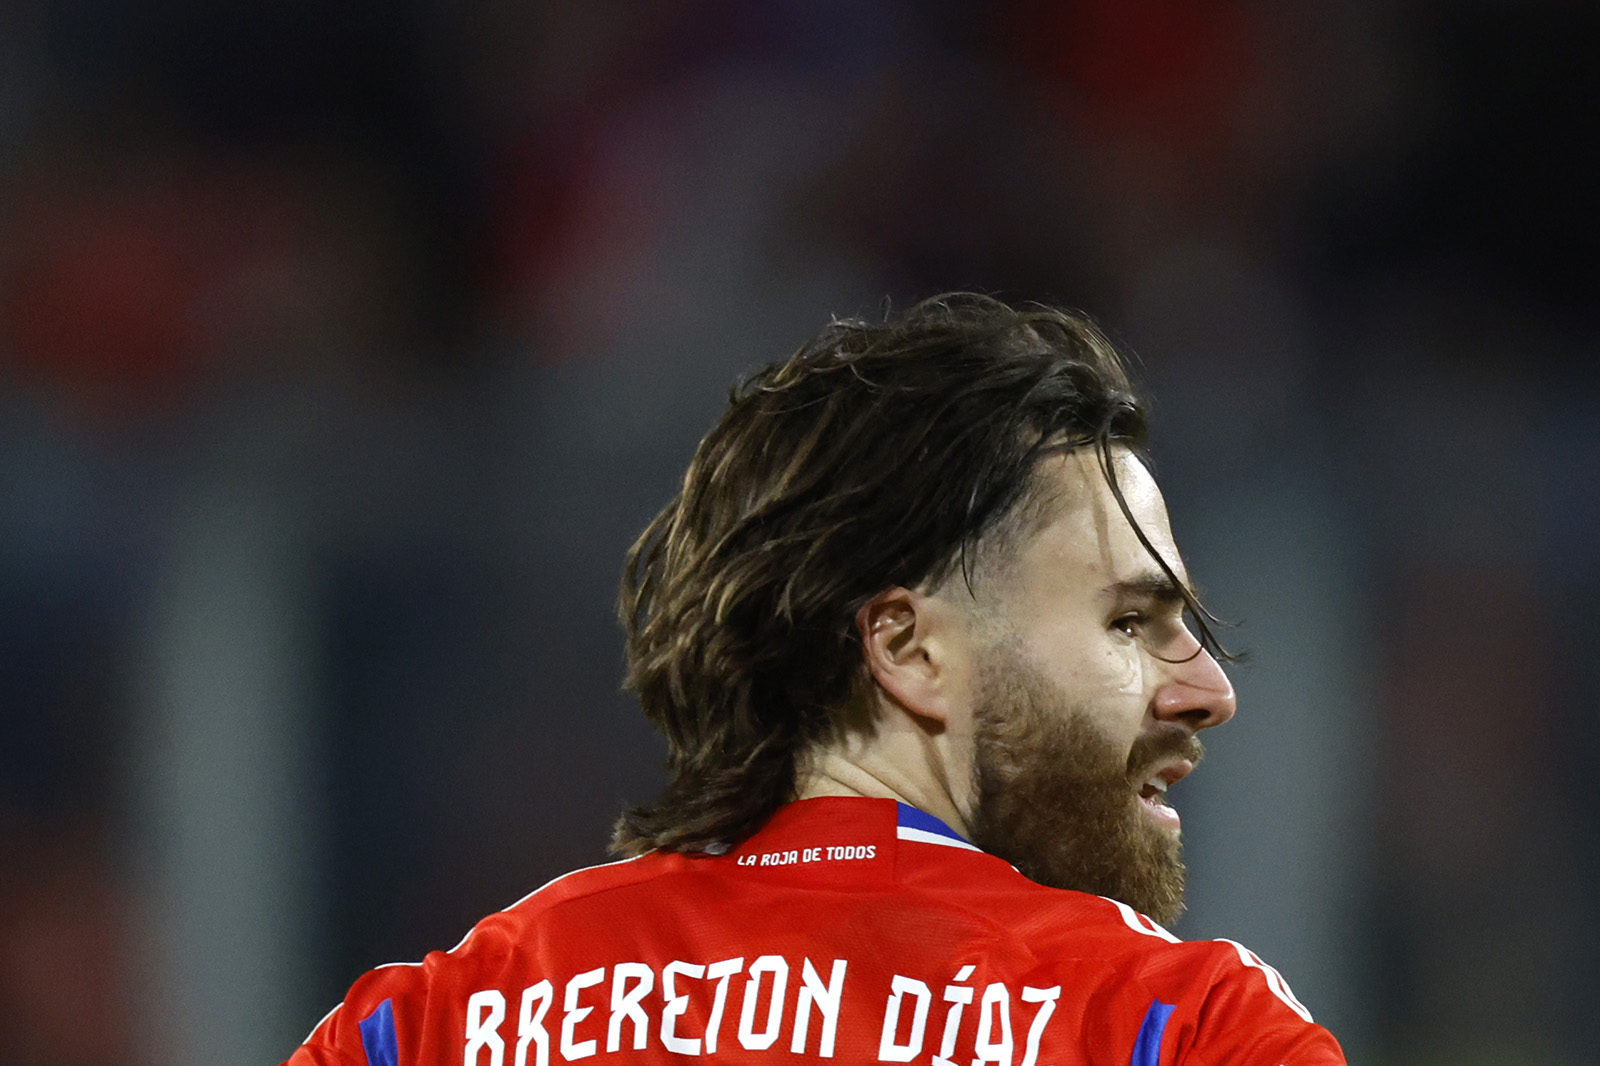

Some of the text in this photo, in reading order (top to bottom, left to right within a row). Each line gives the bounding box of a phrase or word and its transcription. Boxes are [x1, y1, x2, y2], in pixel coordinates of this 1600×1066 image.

[737, 845, 876, 867] LA ROJA DE TODOS
